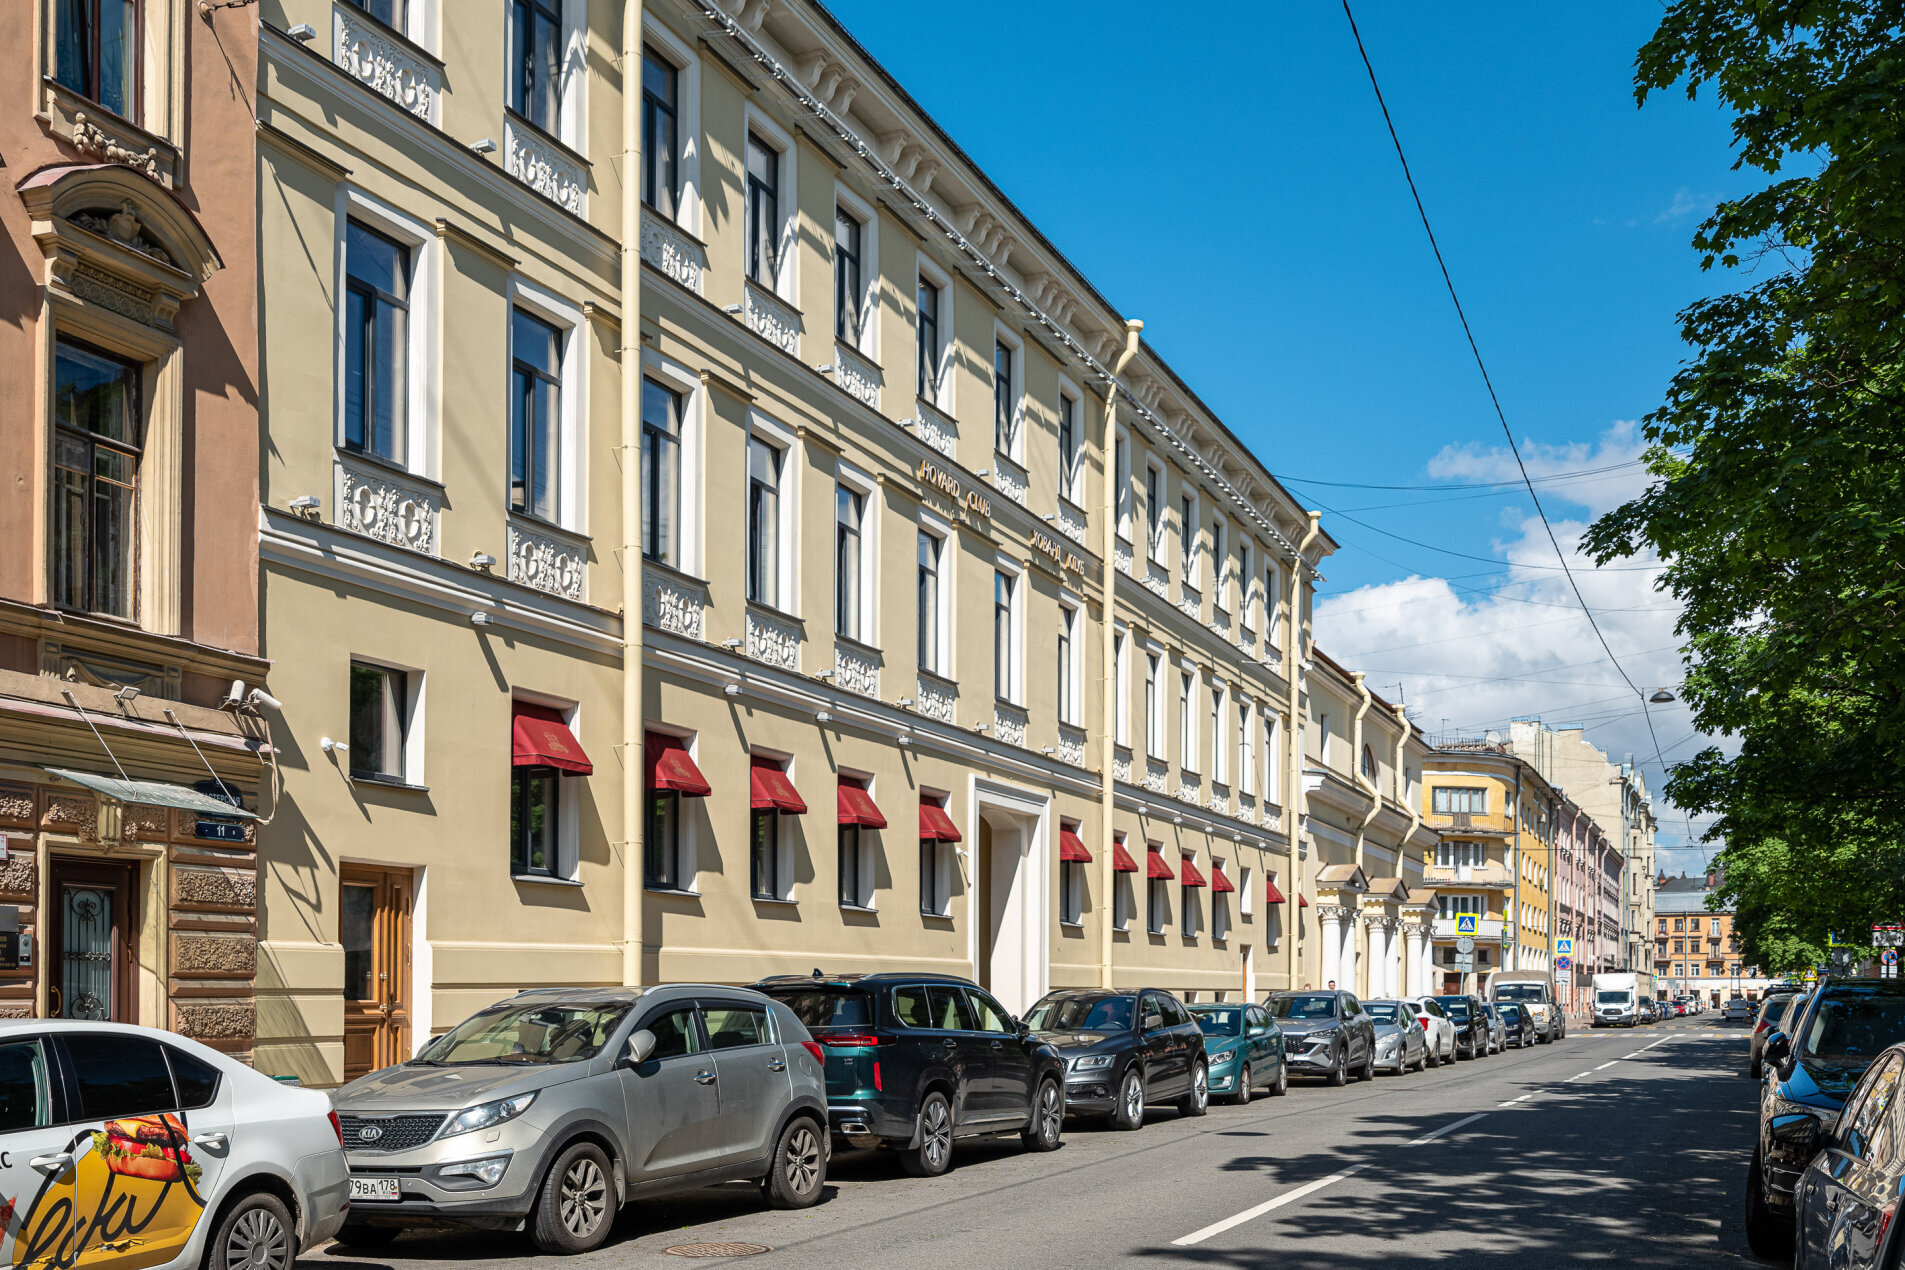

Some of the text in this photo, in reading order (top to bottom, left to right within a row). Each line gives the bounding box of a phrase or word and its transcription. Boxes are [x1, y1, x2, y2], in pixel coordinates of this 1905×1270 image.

[920, 460, 991, 518] HOVARD CLUB
[1031, 529, 1085, 576] ХОВАРД КЛУБ
[216, 825, 225, 837] 11
[361, 1128, 378, 1138] KIA
[379, 1180, 395, 1191] 178
